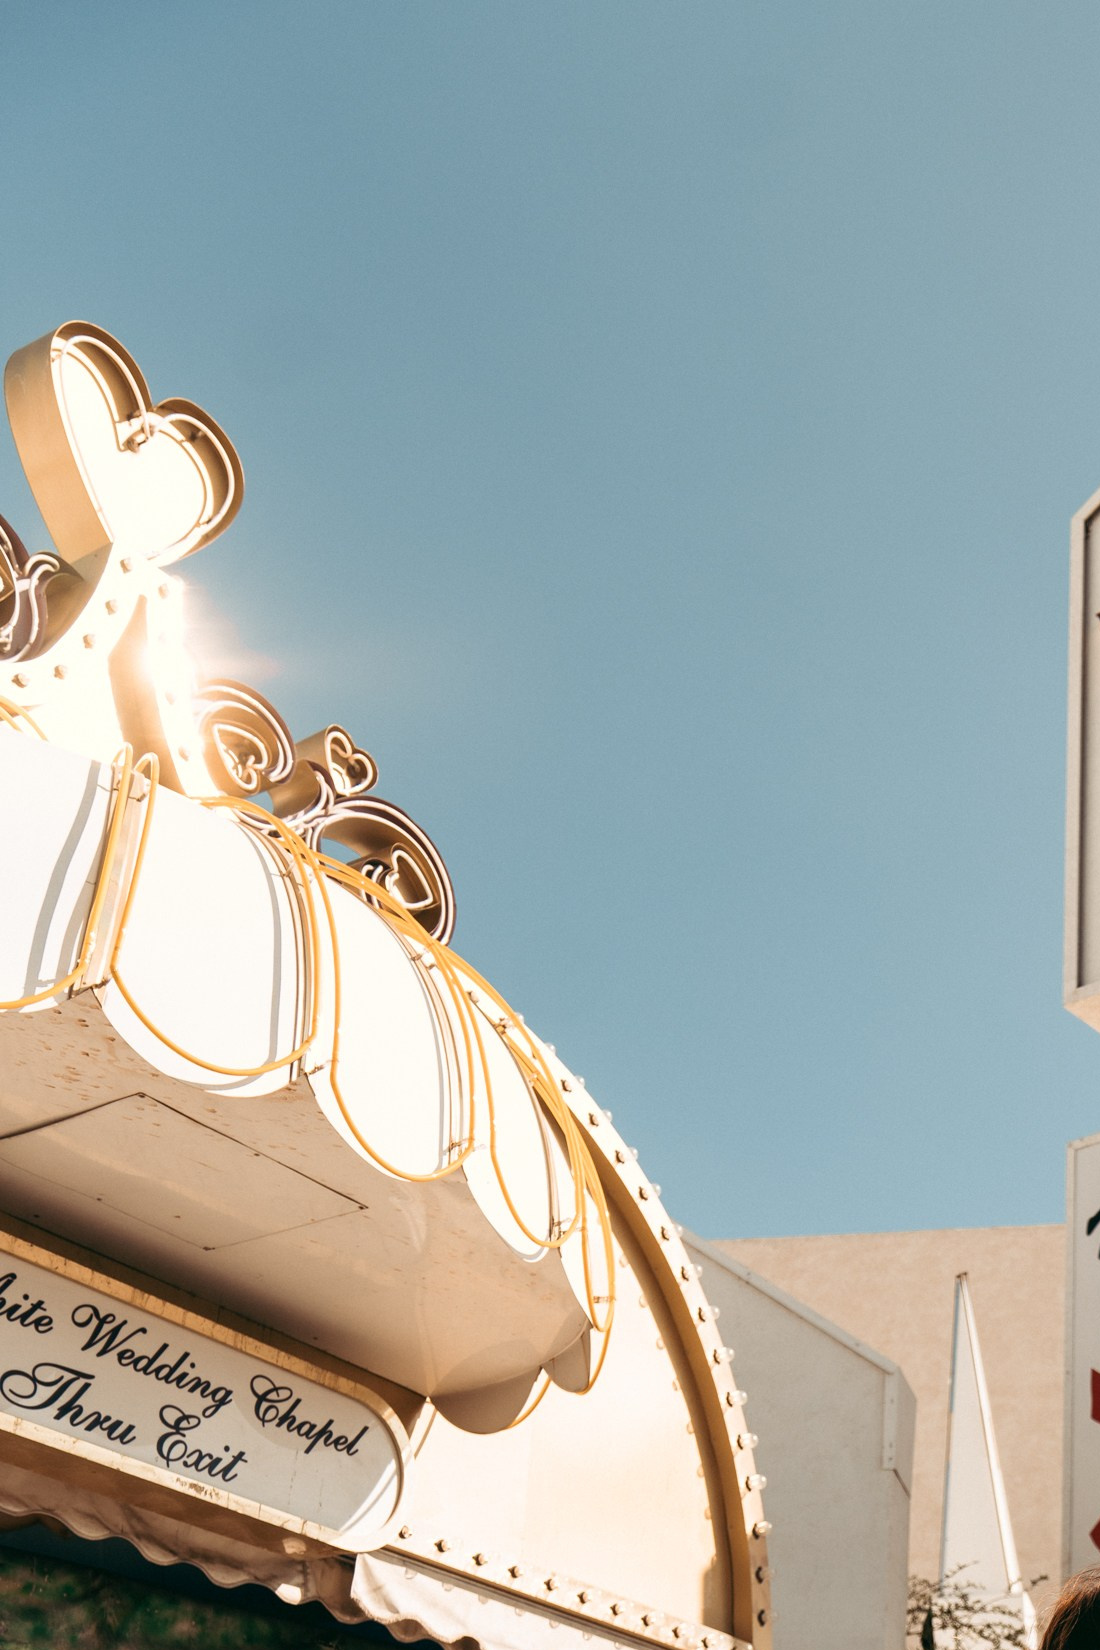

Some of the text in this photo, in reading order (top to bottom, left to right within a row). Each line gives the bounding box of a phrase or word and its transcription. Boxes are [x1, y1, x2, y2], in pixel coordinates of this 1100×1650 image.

[0, 1362, 248, 1482] Thru Exit
[71, 1304, 233, 1418] Wedding
[250, 1374, 369, 1457] Chapel
